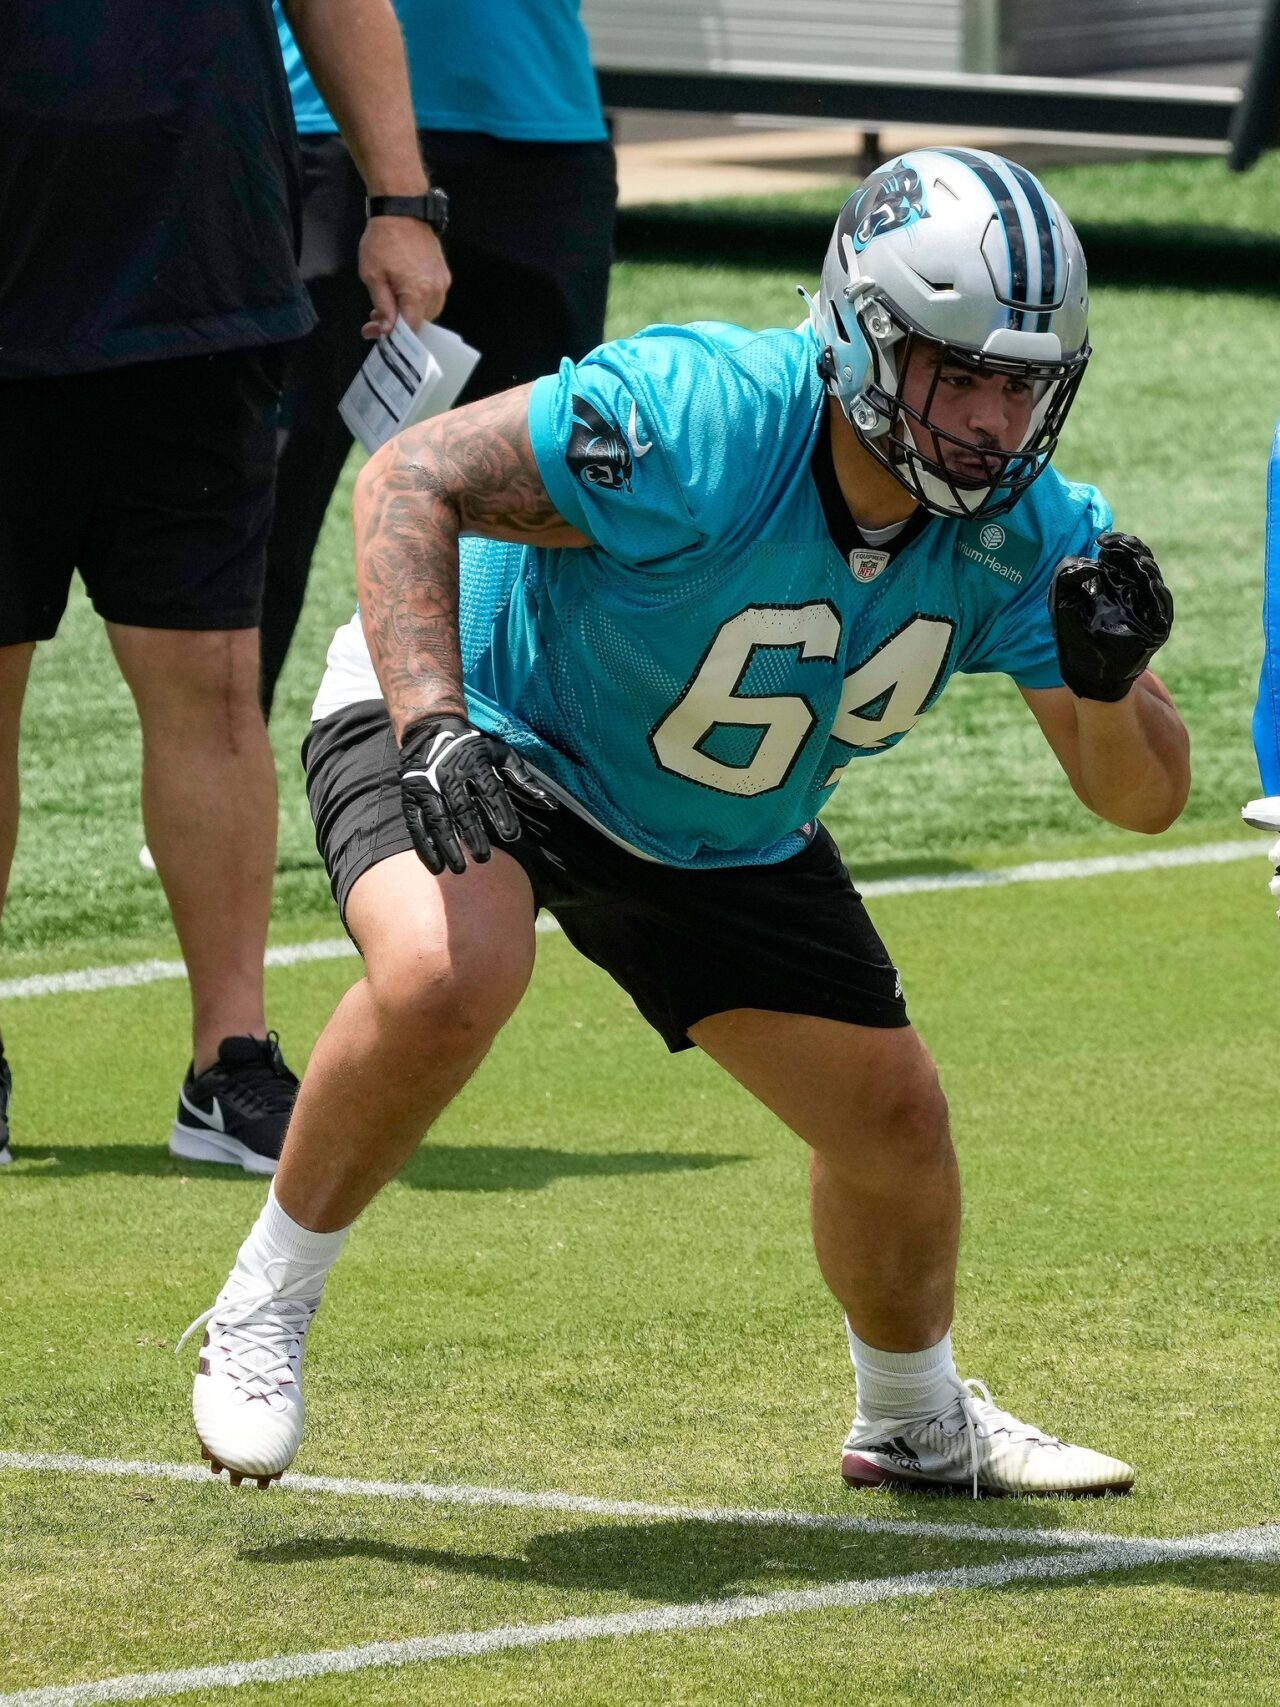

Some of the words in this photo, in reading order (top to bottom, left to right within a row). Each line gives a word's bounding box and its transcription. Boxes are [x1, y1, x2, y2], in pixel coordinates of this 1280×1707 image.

[855, 553, 886, 562] EQUIPMENT
[954, 540, 983, 562] rium
[983, 553, 1023, 585] Health
[858, 567, 875, 577] NFL
[647, 598, 957, 798] 64
